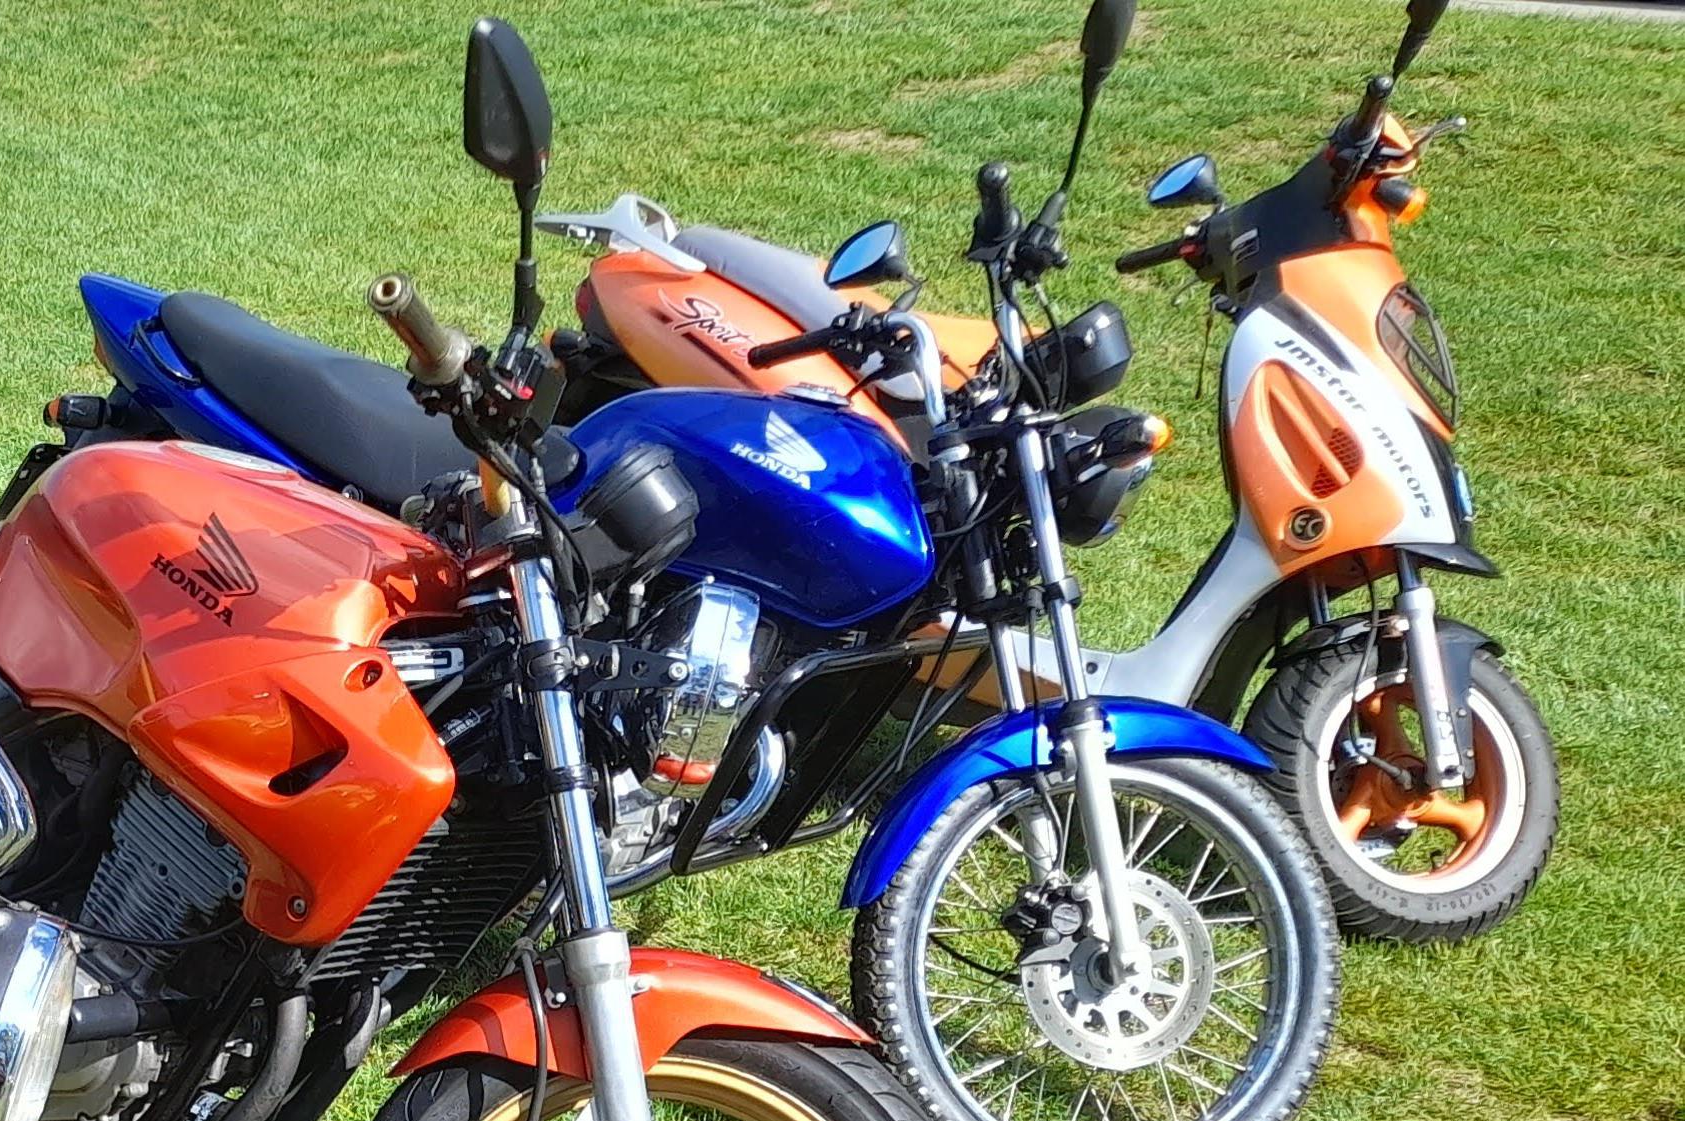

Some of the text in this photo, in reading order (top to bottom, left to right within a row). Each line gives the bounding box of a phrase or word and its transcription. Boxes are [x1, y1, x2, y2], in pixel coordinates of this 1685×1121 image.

[657, 288, 757, 344] Sport
[729, 441, 812, 490] HONDA
[1372, 426, 1435, 519] motors
[149, 553, 234, 628] HONDA
